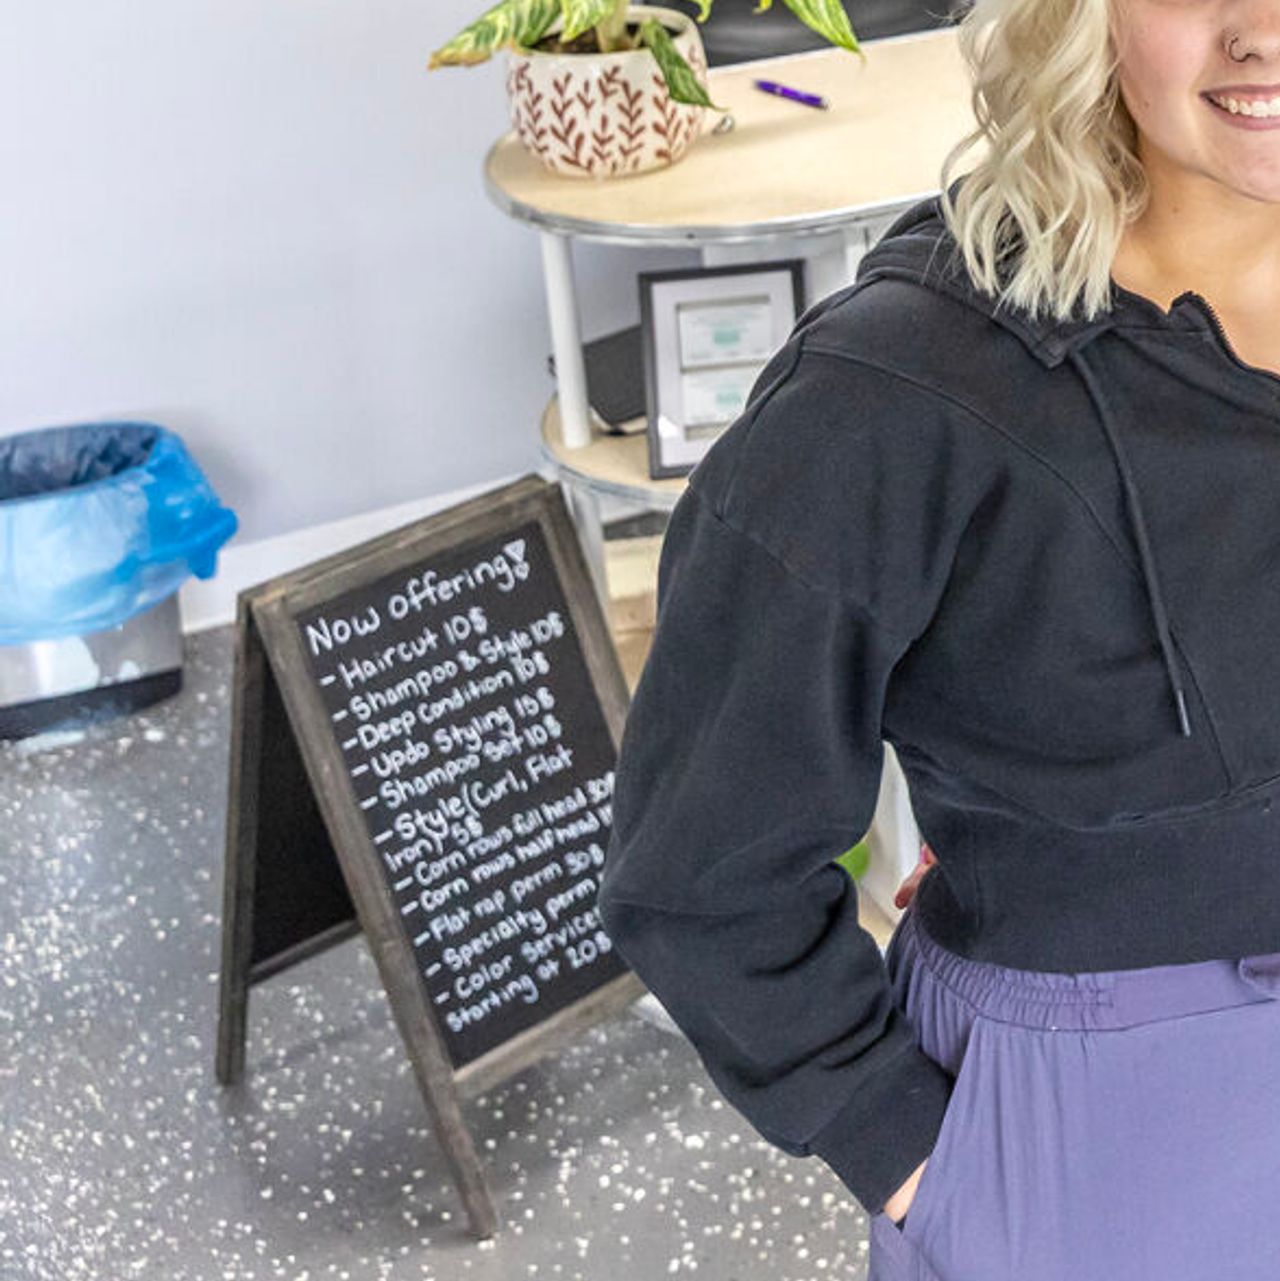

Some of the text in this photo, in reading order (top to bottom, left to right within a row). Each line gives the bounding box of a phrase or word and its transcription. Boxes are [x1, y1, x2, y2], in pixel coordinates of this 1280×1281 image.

[306, 538, 530, 656] Now offering!
[339, 627, 439, 690] Haircut
[443, 606, 488, 645] 10$
[350, 660, 458, 721] Shampoo
[456, 649, 481, 671] &
[478, 629, 533, 667] Style
[529, 611, 565, 644] 10$
[357, 709, 416, 750] Deep
[417, 669, 514, 724] Condition
[513, 650, 550, 683] 10$
[371, 738, 430, 778] Updo
[433, 705, 515, 753] Styling
[380, 753, 481, 809] Shampoo
[523, 714, 562, 748] 10$
[525, 744, 573, 783] Flat
[414, 850, 468, 886] Corn
[467, 825, 513, 859] rows
[512, 808, 544, 836] full
[541, 786, 588, 823] head
[420, 877, 470, 912] Corn
[471, 851, 516, 884] rows
[514, 827, 555, 863] half
[554, 810, 600, 845] head
[429, 906, 471, 942] Flat
[510, 862, 563, 904] perm
[442, 907, 548, 971] Specialty
[545, 877, 596, 920] perm
[446, 930, 612, 1032] Starting at 20$
[454, 955, 513, 999] Color
